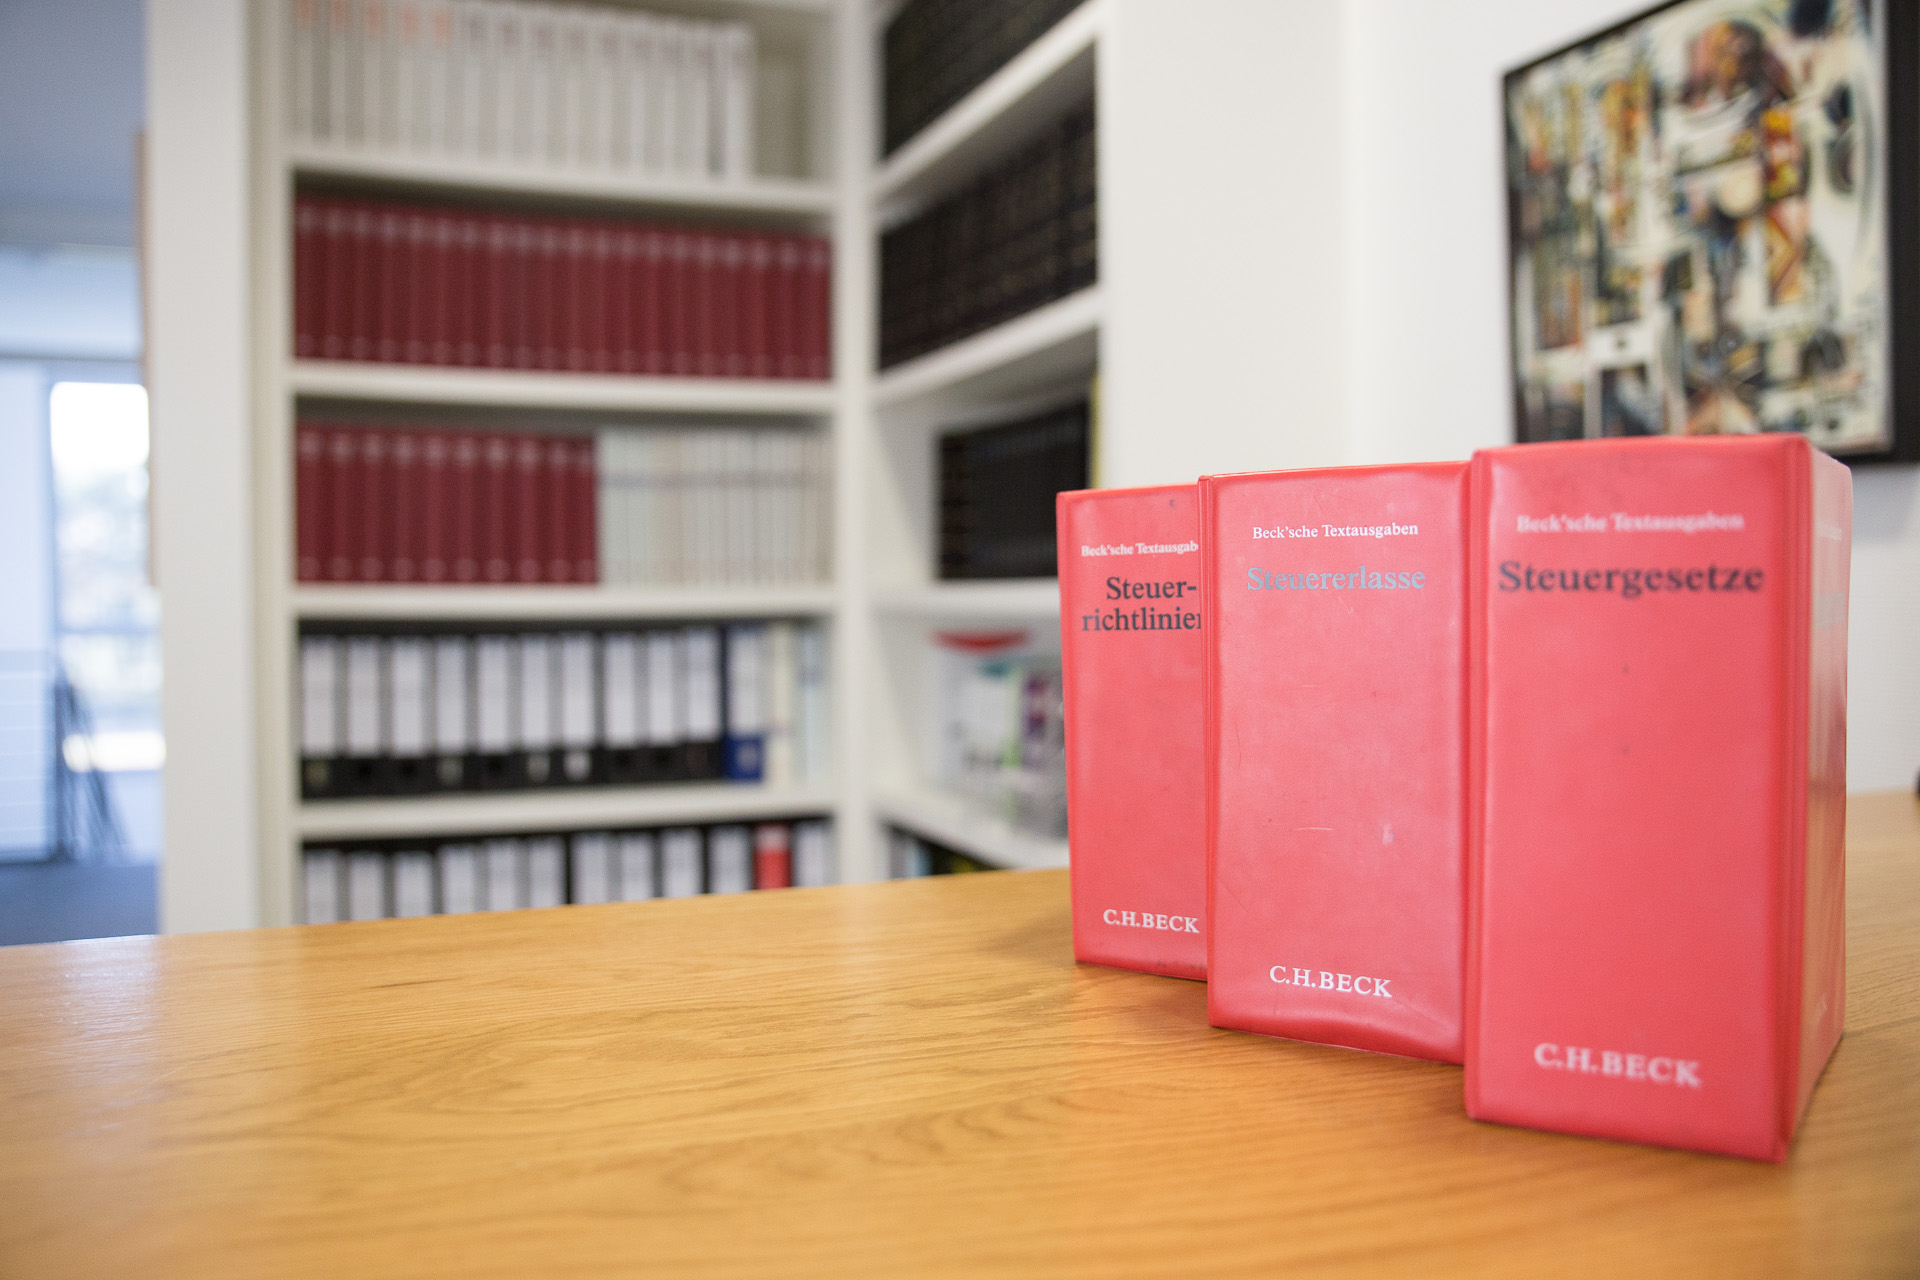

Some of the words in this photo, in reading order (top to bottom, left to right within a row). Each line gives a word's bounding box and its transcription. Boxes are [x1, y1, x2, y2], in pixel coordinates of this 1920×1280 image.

[1252, 525, 1318, 540] Beck'sche
[1321, 522, 1419, 539] Textausgaben
[1516, 513, 1607, 533] Beck'sche
[1611, 511, 1744, 534] Textausgaben
[1081, 542, 1134, 557] Beck'sche
[1135, 540, 1199, 555] Textausgab
[1106, 576, 1198, 601] Steuer-
[1247, 565, 1426, 591] Steuererlasse
[1499, 561, 1765, 599] Steuergesetze
[1103, 909, 1200, 934] C.H.BECK
[1269, 965, 1392, 998] C.H.BECK
[1534, 1042, 1702, 1088] C.H.BECK
